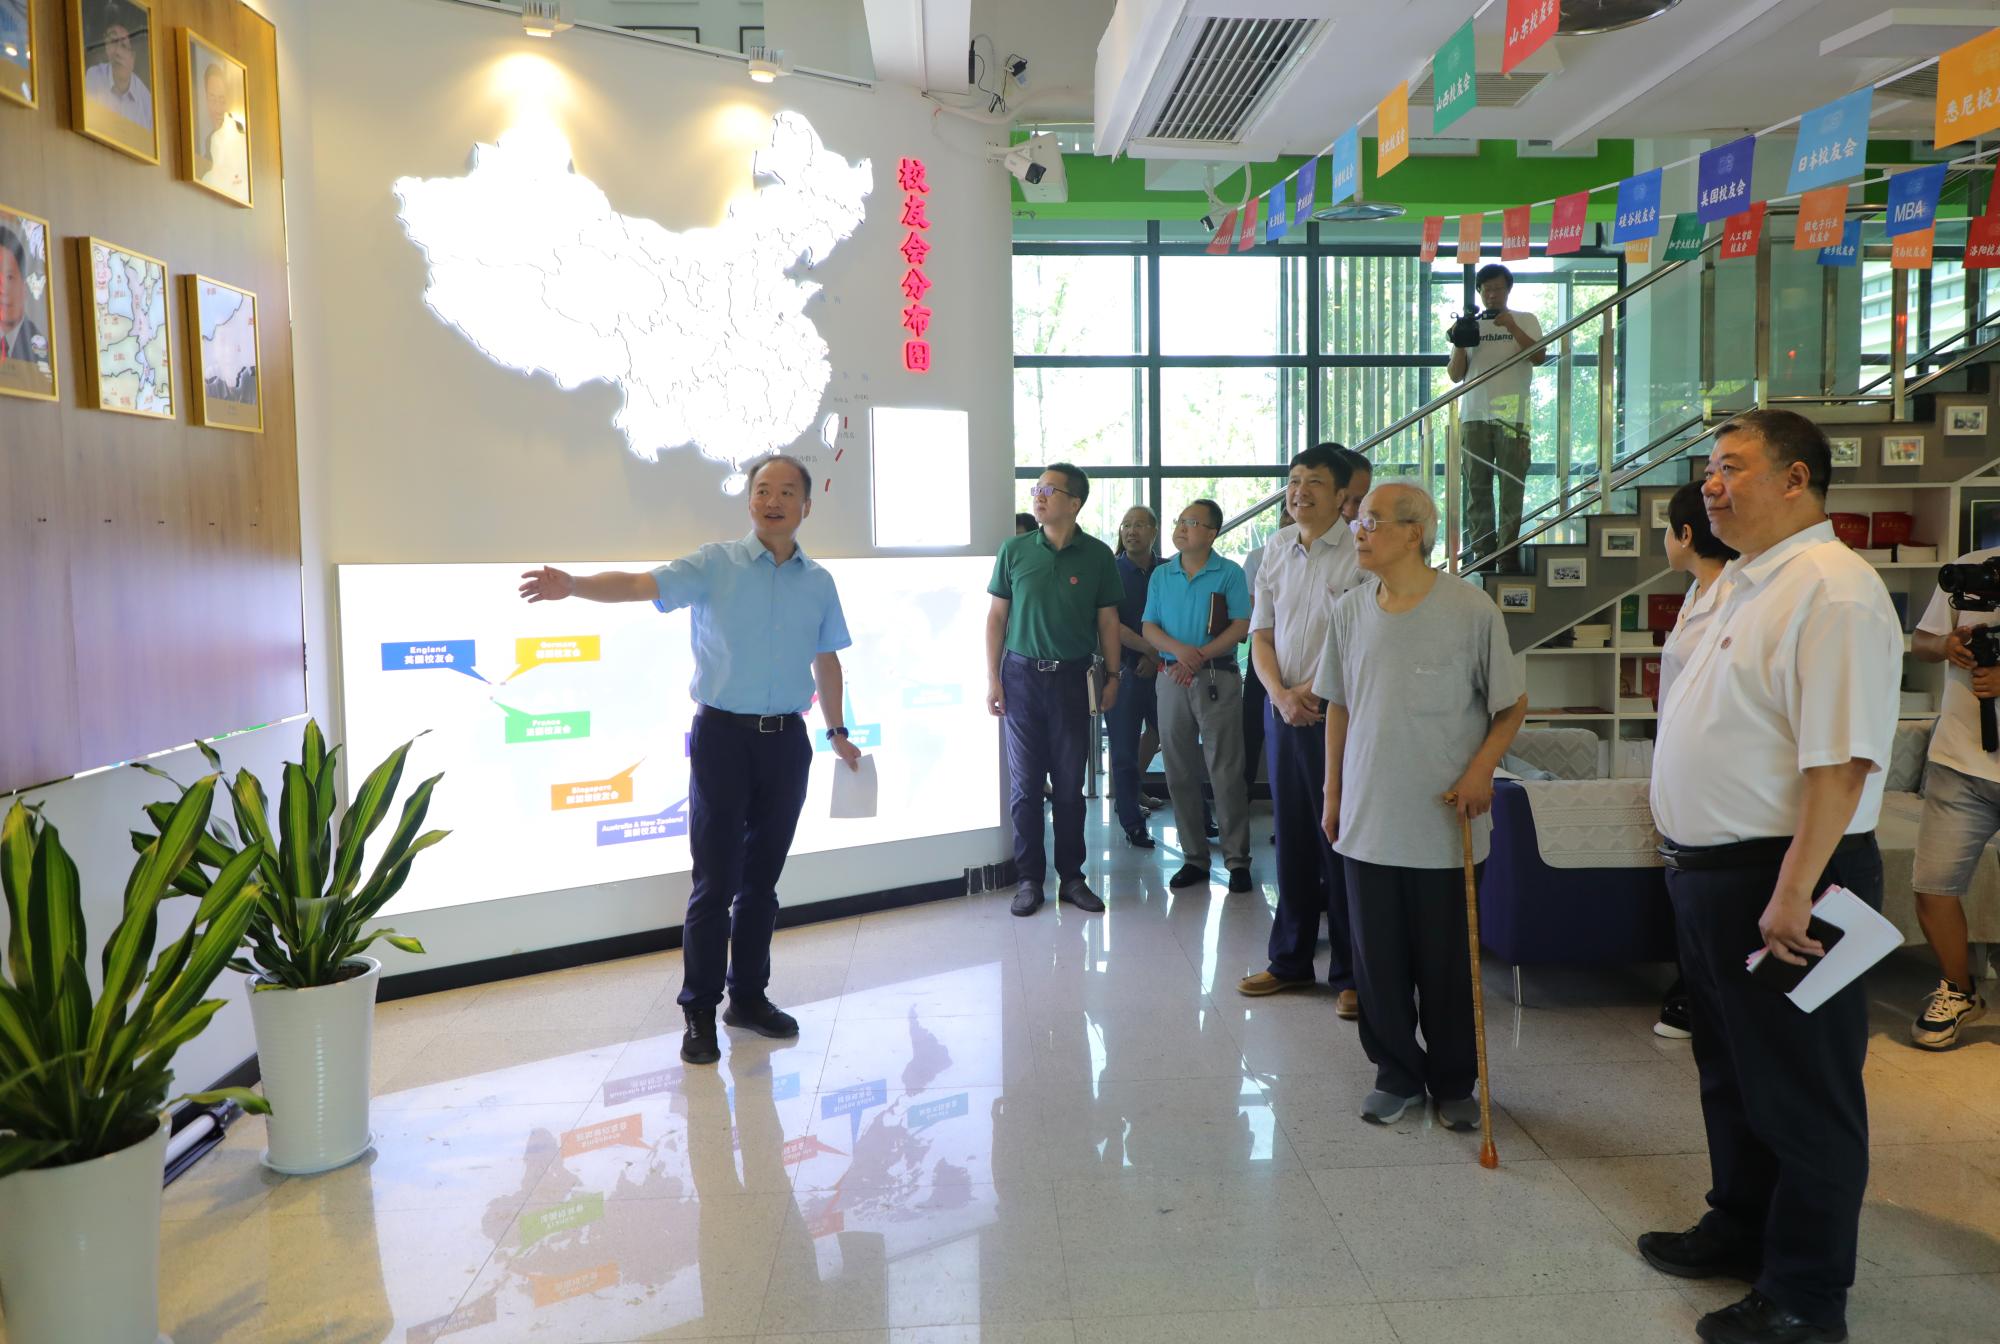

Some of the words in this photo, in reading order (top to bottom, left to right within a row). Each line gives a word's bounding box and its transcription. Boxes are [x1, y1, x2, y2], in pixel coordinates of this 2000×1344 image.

[1436, 71, 1471, 112] 山西校友会
[1797, 137, 1857, 173] 日本校友会
[1700, 178, 1746, 208] 美国校友会
[1618, 206, 1656, 228] 硅谷校友会
[1894, 200, 1923, 223] MBA
[899, 158, 932, 372] 校友会分布图
[409, 645, 447, 655] England
